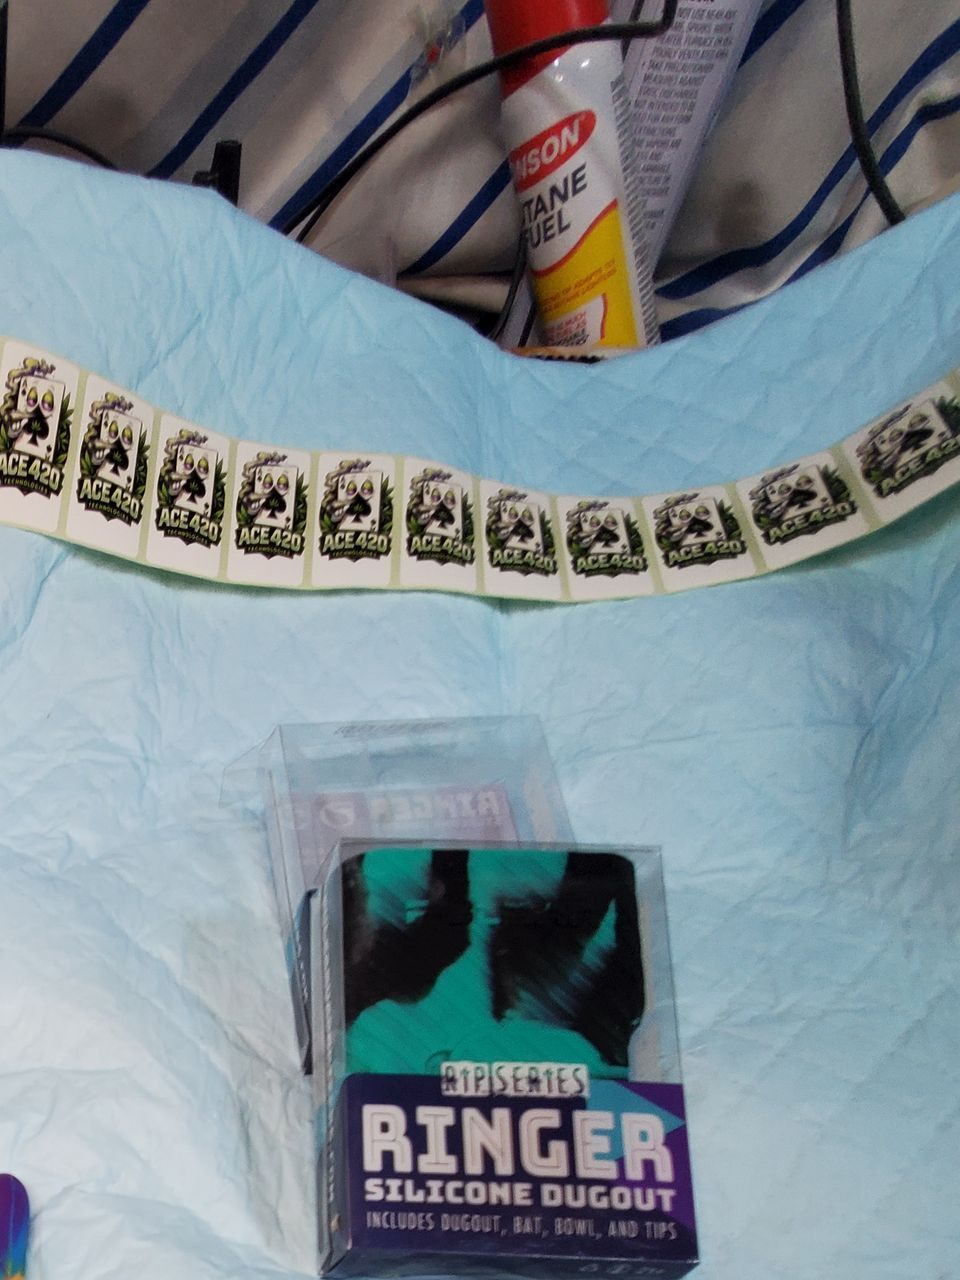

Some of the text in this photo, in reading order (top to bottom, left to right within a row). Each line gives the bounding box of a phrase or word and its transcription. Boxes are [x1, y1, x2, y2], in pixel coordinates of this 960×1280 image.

[28, 461, 62, 491] 420
[79, 478, 140, 519] ACE 420
[158, 508, 219, 542] ACE 420
[768, 502, 852, 542] ACE 420
[239, 526, 302, 552] ACE 420
[322, 530, 388, 552] ACE 420
[410, 536, 441, 554] ACE
[439, 539, 472, 562] 420
[668, 540, 741, 564] ACE 420
[492, 550, 522, 566] ACE
[522, 551, 555, 573] 420
[576, 554, 643, 572] ACE 420
[362, 1103, 676, 1183] RINGER
[364, 1177, 677, 1212] SILICONE DUGOUT
[366, 1211, 678, 1240] INCLUDES DUGOUT, BAT, BOWL, AND TIPS
